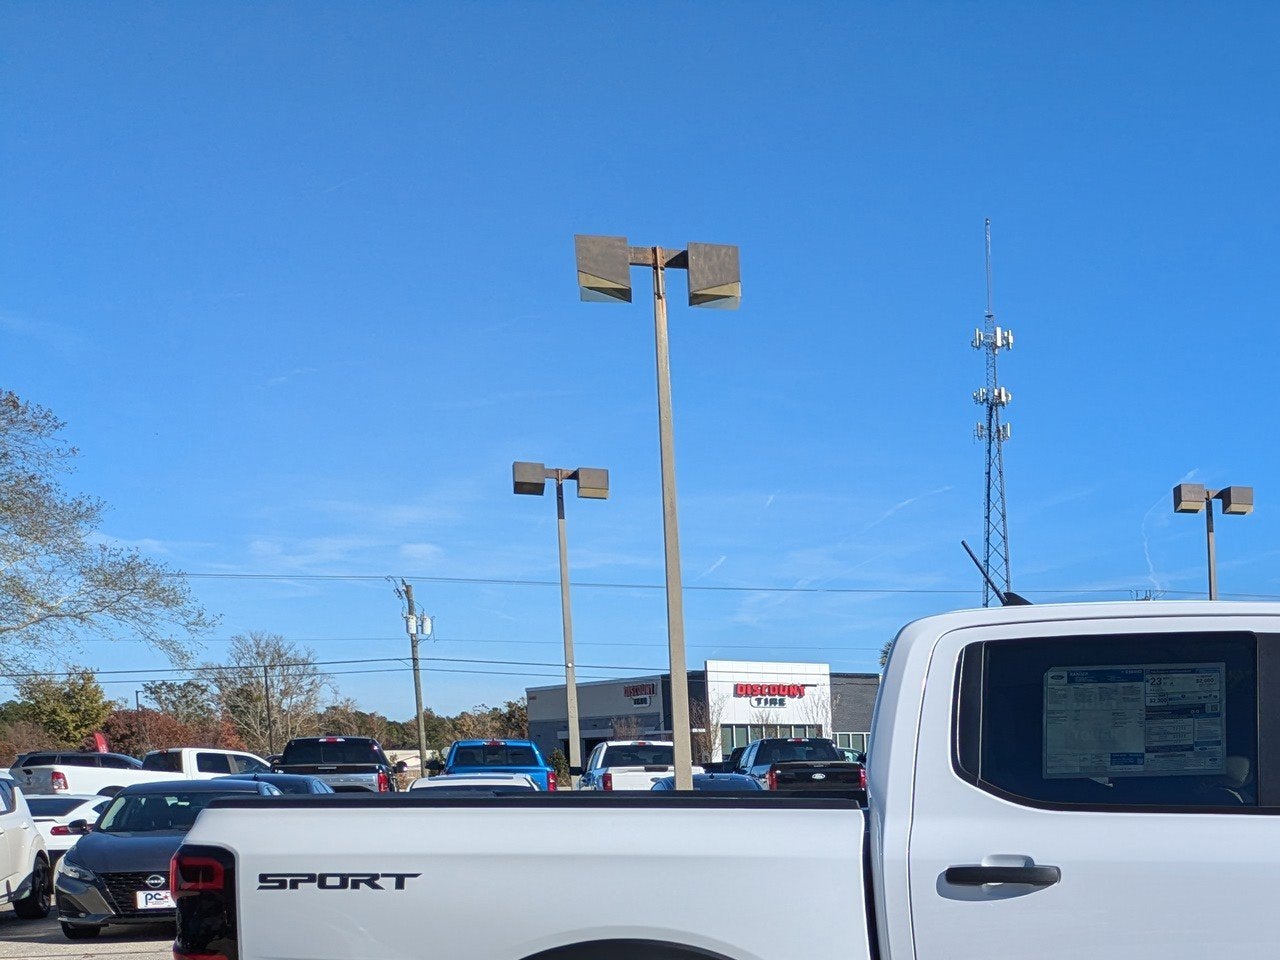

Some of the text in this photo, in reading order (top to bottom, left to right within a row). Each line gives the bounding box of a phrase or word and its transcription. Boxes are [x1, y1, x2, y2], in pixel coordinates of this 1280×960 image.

[734, 683, 805, 698] DISCOUNT
[754, 697, 787, 707] TIRE
[257, 873, 423, 890] SPORT
